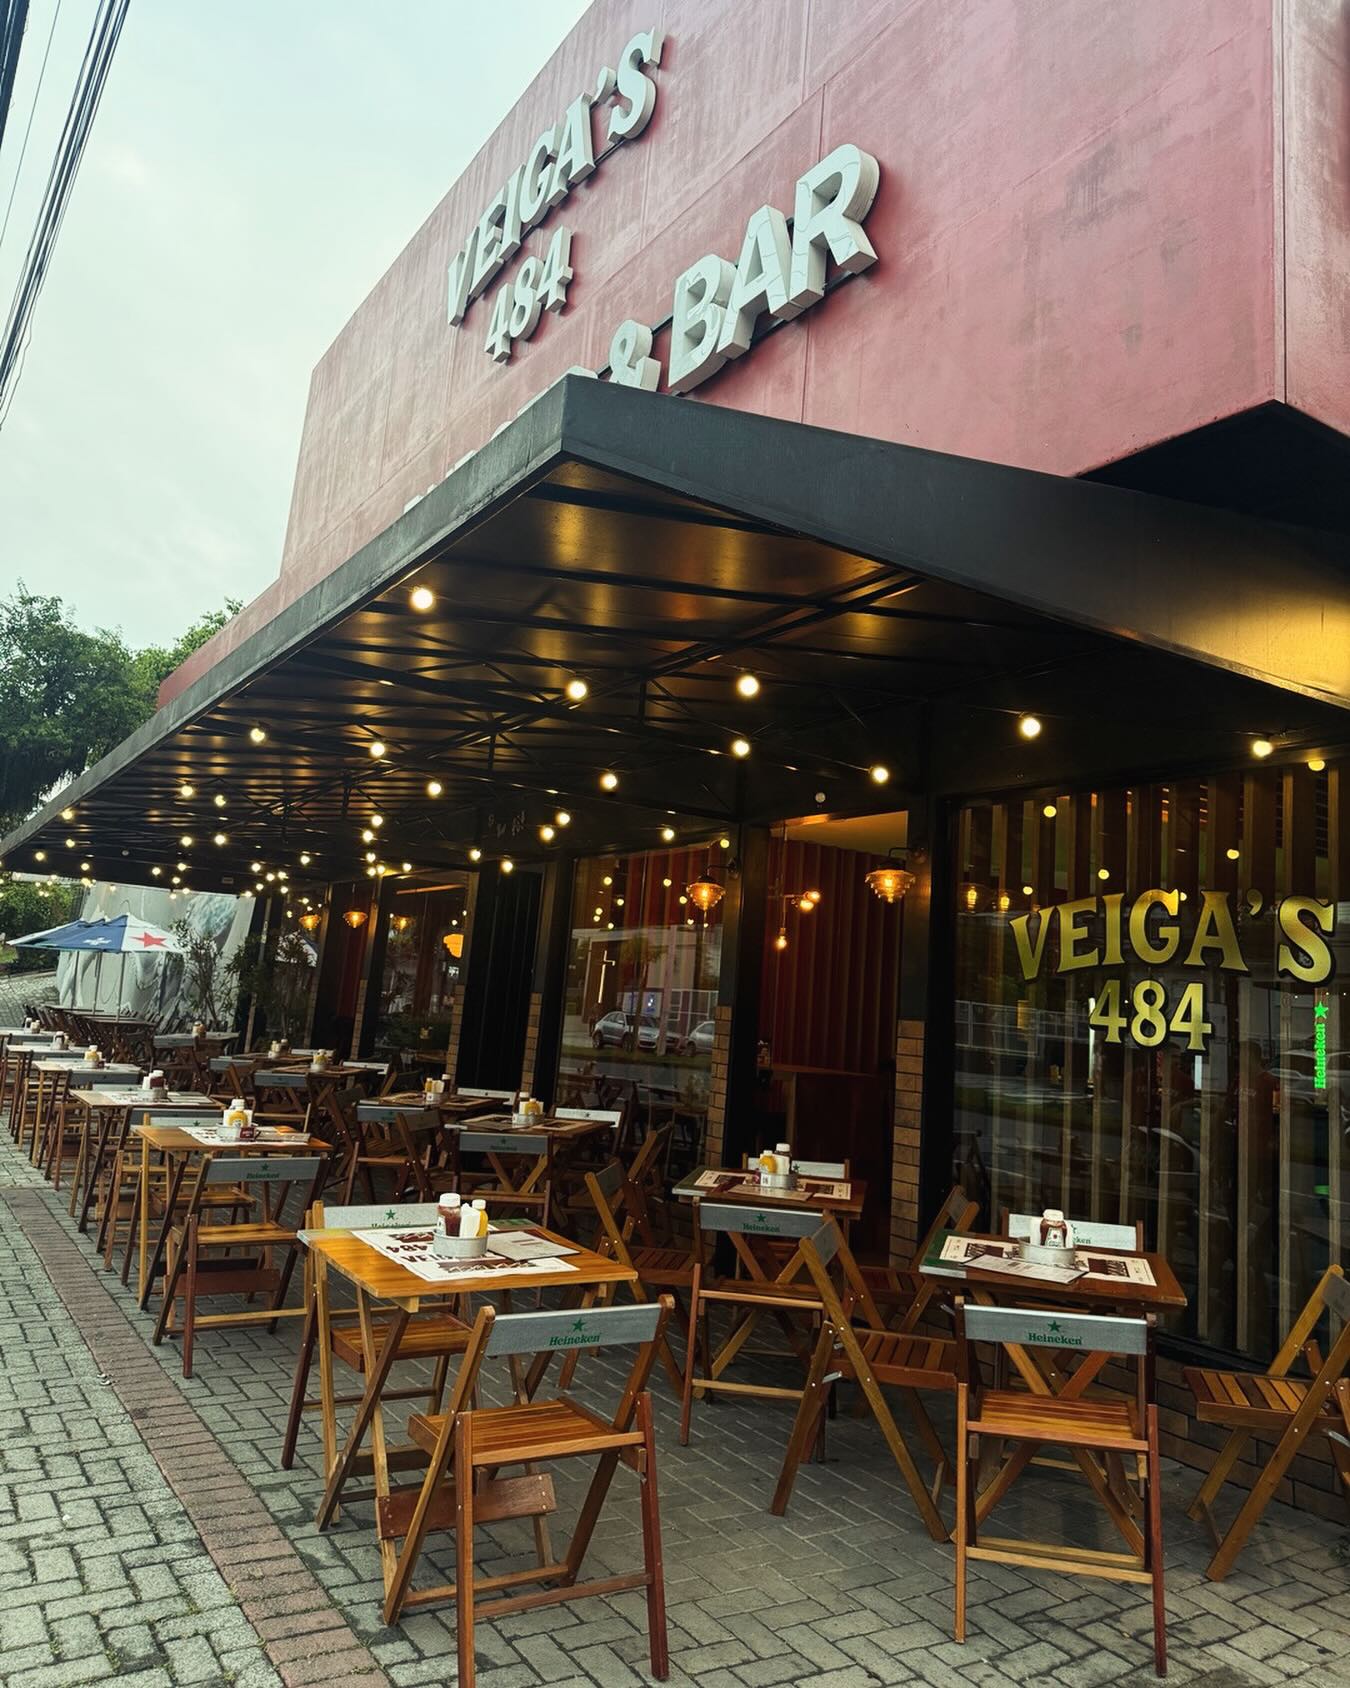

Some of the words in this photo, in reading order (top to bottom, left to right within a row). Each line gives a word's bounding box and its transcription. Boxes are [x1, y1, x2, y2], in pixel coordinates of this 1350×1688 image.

[448, 27, 663, 327] VEIGA'S
[484, 225, 574, 363] 484
[609, 319, 661, 392] &
[668, 143, 880, 393] BAR
[1009, 889, 1334, 983] VEIGA'S
[1089, 979, 1212, 1050] 484
[1314, 1023, 1327, 1089] Heineken
[549, 1334, 600, 1346] Heineken
[1028, 1332, 1082, 1345] Heineken
